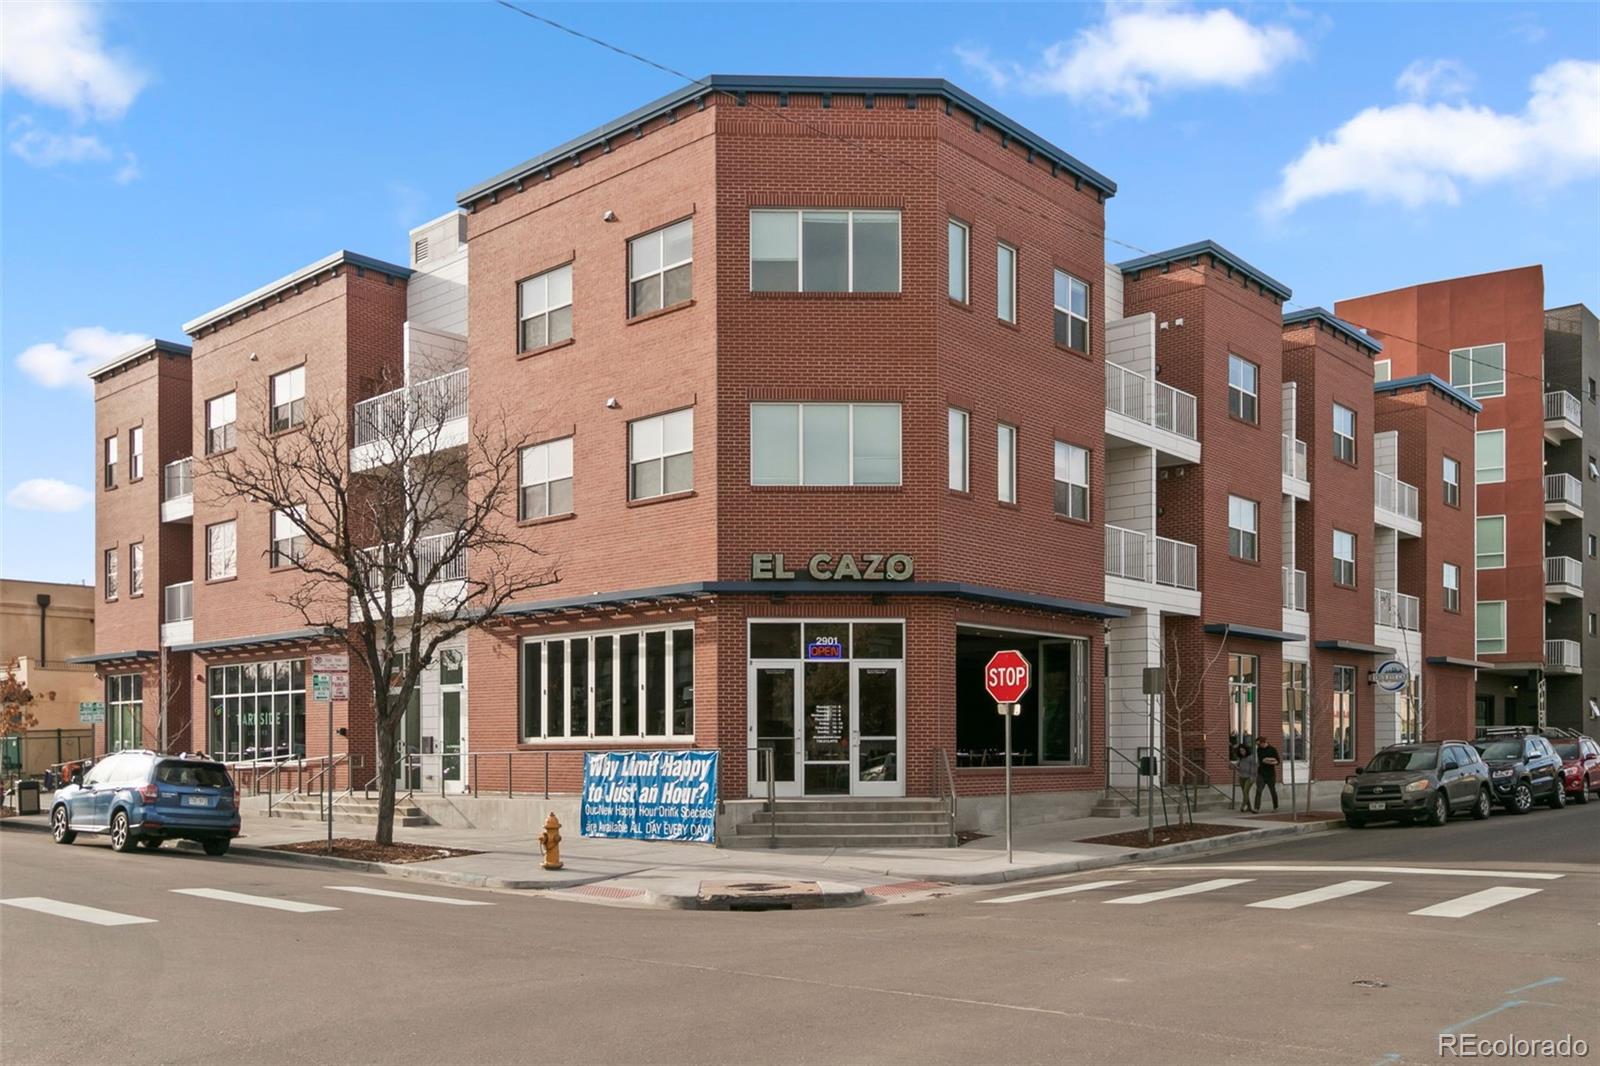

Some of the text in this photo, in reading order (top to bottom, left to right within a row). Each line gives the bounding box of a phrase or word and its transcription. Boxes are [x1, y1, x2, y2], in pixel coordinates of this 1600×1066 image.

[752, 553, 914, 582] EL CAZO
[815, 636, 838, 645] 2901
[811, 646, 839, 657] OPEN
[989, 667, 1025, 687] STOP
[236, 712, 281, 727] ARSIDE
[590, 755, 712, 781] Why Limit Happy
[588, 782, 709, 804] to Just an Hour?
[600, 805, 614, 816] New
[615, 805, 637, 818] Happy
[639, 805, 659, 817] Hour
[659, 805, 679, 817] Drink
[585, 822, 597, 833] are
[599, 822, 628, 833] Available
[630, 822, 643, 834] ALL
[646, 823, 661, 834] DAY
[663, 823, 688, 836] EVERY
